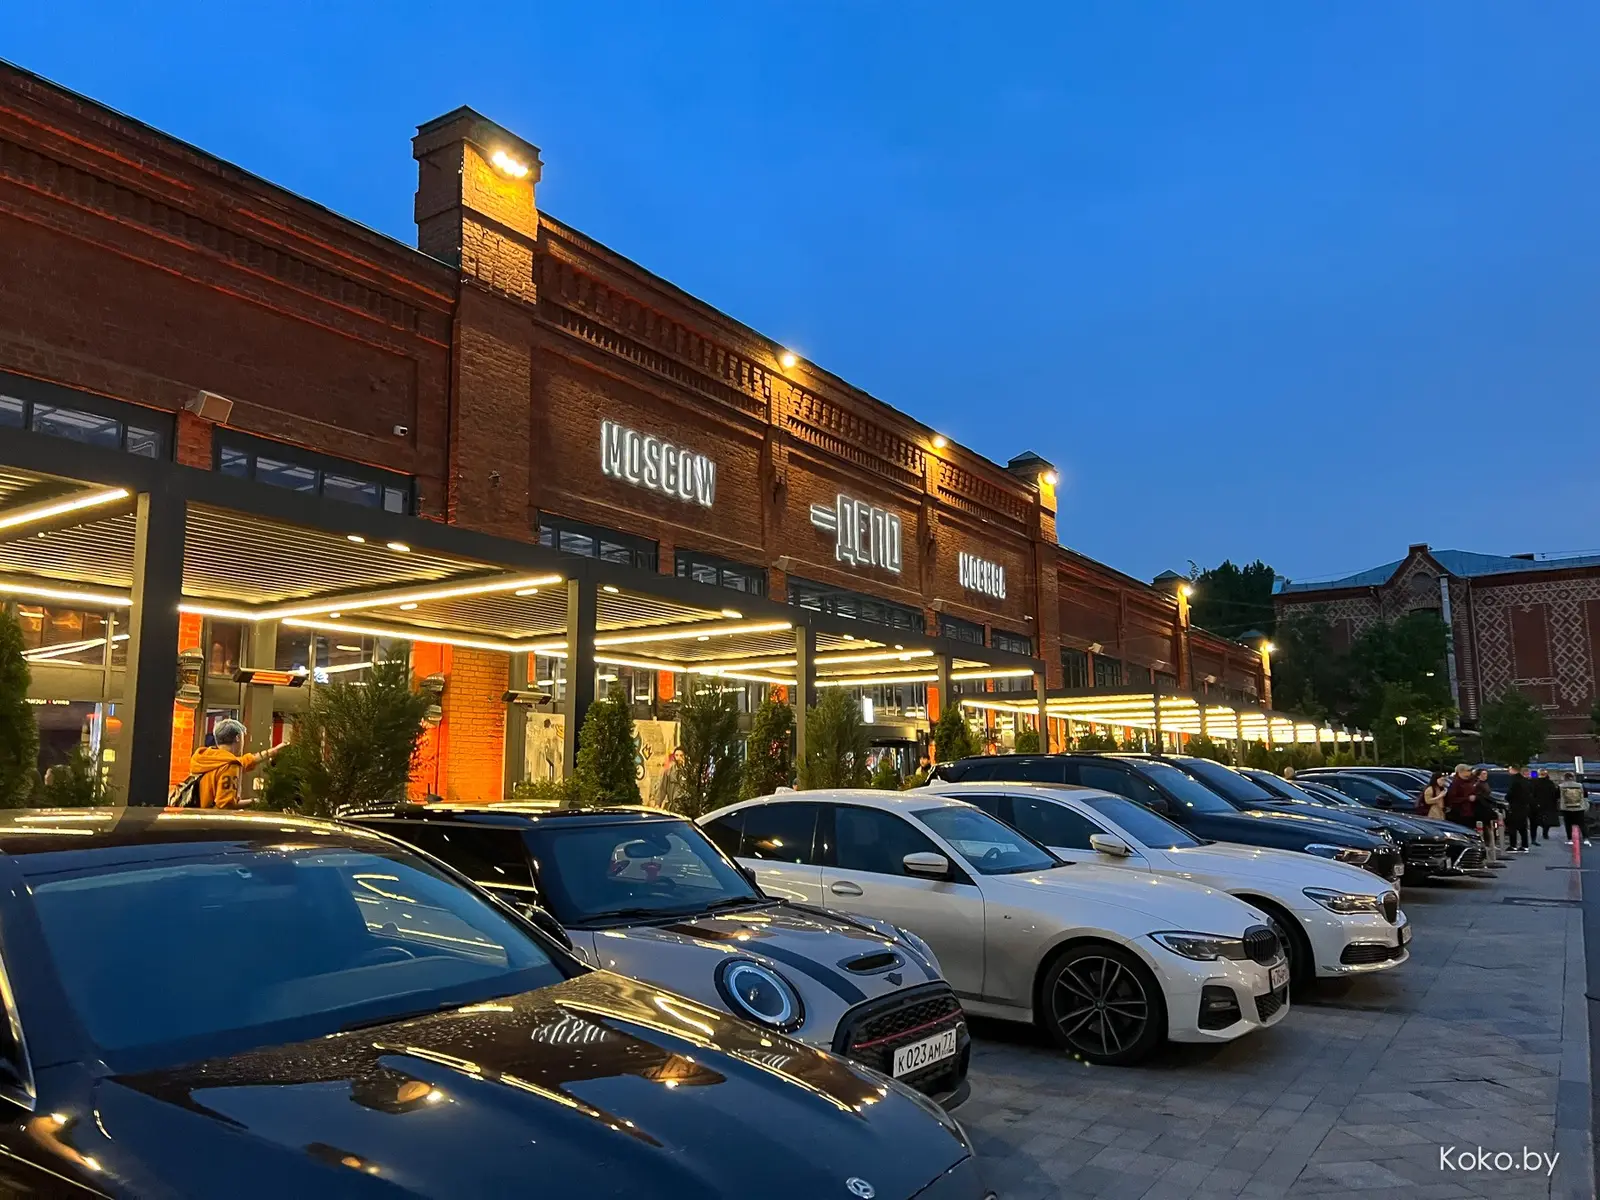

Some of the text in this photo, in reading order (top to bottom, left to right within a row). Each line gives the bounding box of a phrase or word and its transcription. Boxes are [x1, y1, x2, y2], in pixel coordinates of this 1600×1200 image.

[600, 419, 717, 508] MOSCOW
[836, 493, 903, 573] ДЕПО
[958, 551, 1006, 600] МОСКВА
